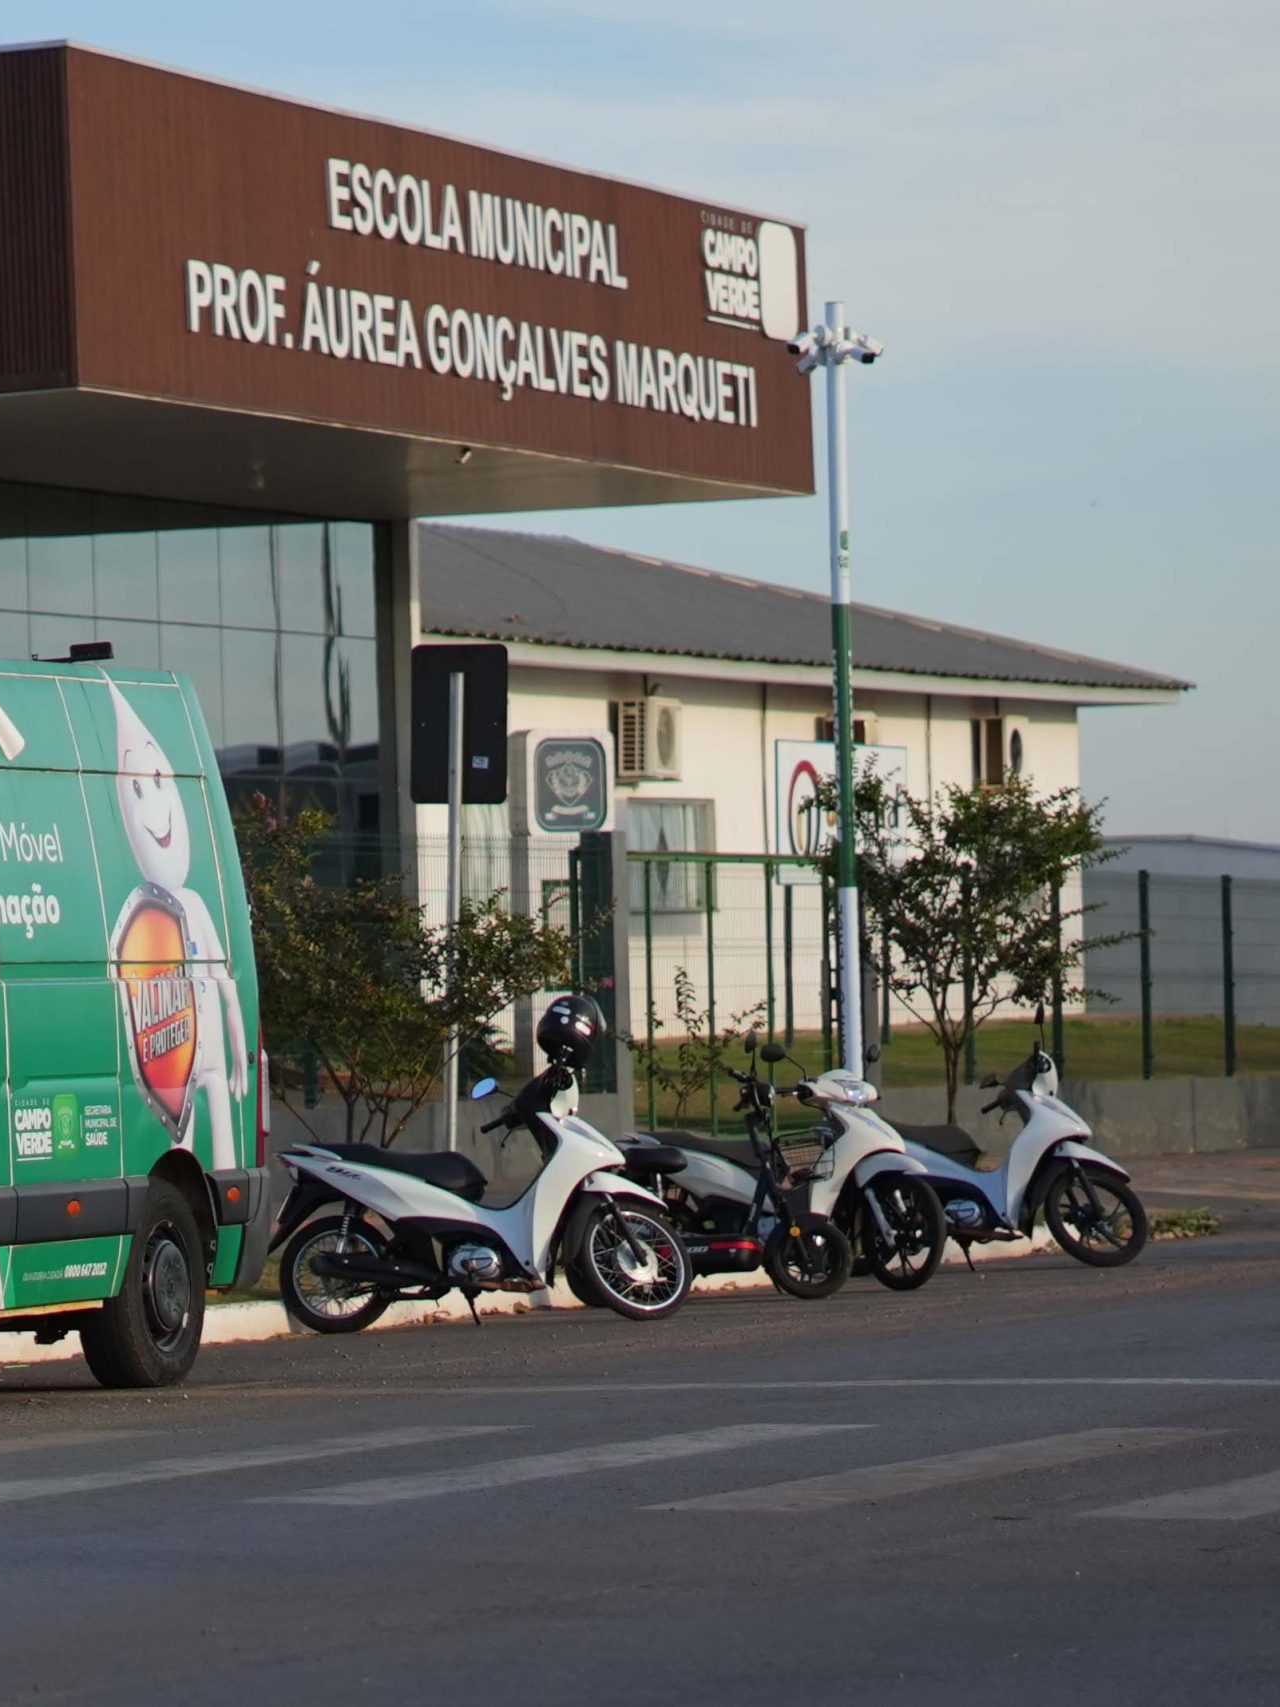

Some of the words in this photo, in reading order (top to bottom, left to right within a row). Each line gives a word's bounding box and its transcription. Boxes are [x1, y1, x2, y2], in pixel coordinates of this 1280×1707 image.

[326, 158, 465, 254] ESCOLA
[468, 190, 628, 289] MUNICIPAL
[703, 227, 758, 278] CAMPO
[704, 269, 761, 320] VERDE
[186, 259, 294, 349] PROF.
[302, 260, 422, 369] ÁUREA
[426, 304, 610, 401] GONÇALVES
[616, 340, 757, 428] MARQUETI
[150, 1018, 190, 1059] PROTEGER
[15, 1107, 52, 1130] CAMPO
[85, 1129, 108, 1146] SAÚDE
[15, 1131, 52, 1155] VERDE
